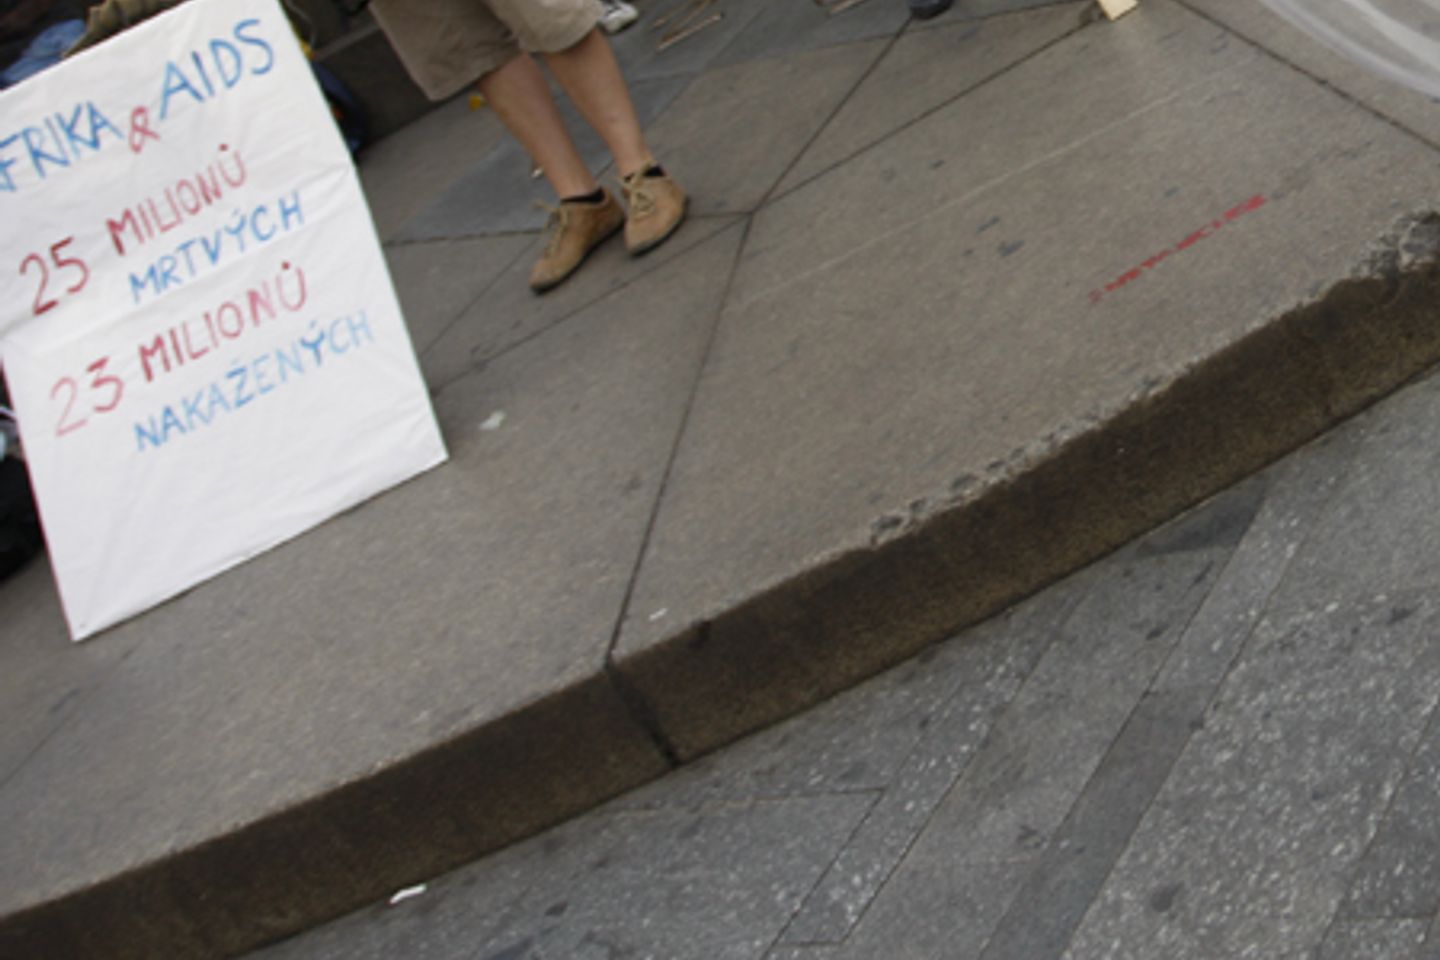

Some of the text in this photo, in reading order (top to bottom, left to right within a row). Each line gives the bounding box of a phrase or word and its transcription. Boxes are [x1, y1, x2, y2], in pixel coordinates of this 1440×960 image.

[0, 101, 124, 193] FRIKA
[158, 18, 275, 121] AIDS
[19, 236, 91, 315] 25
[128, 190, 305, 303] MRTVÝCH
